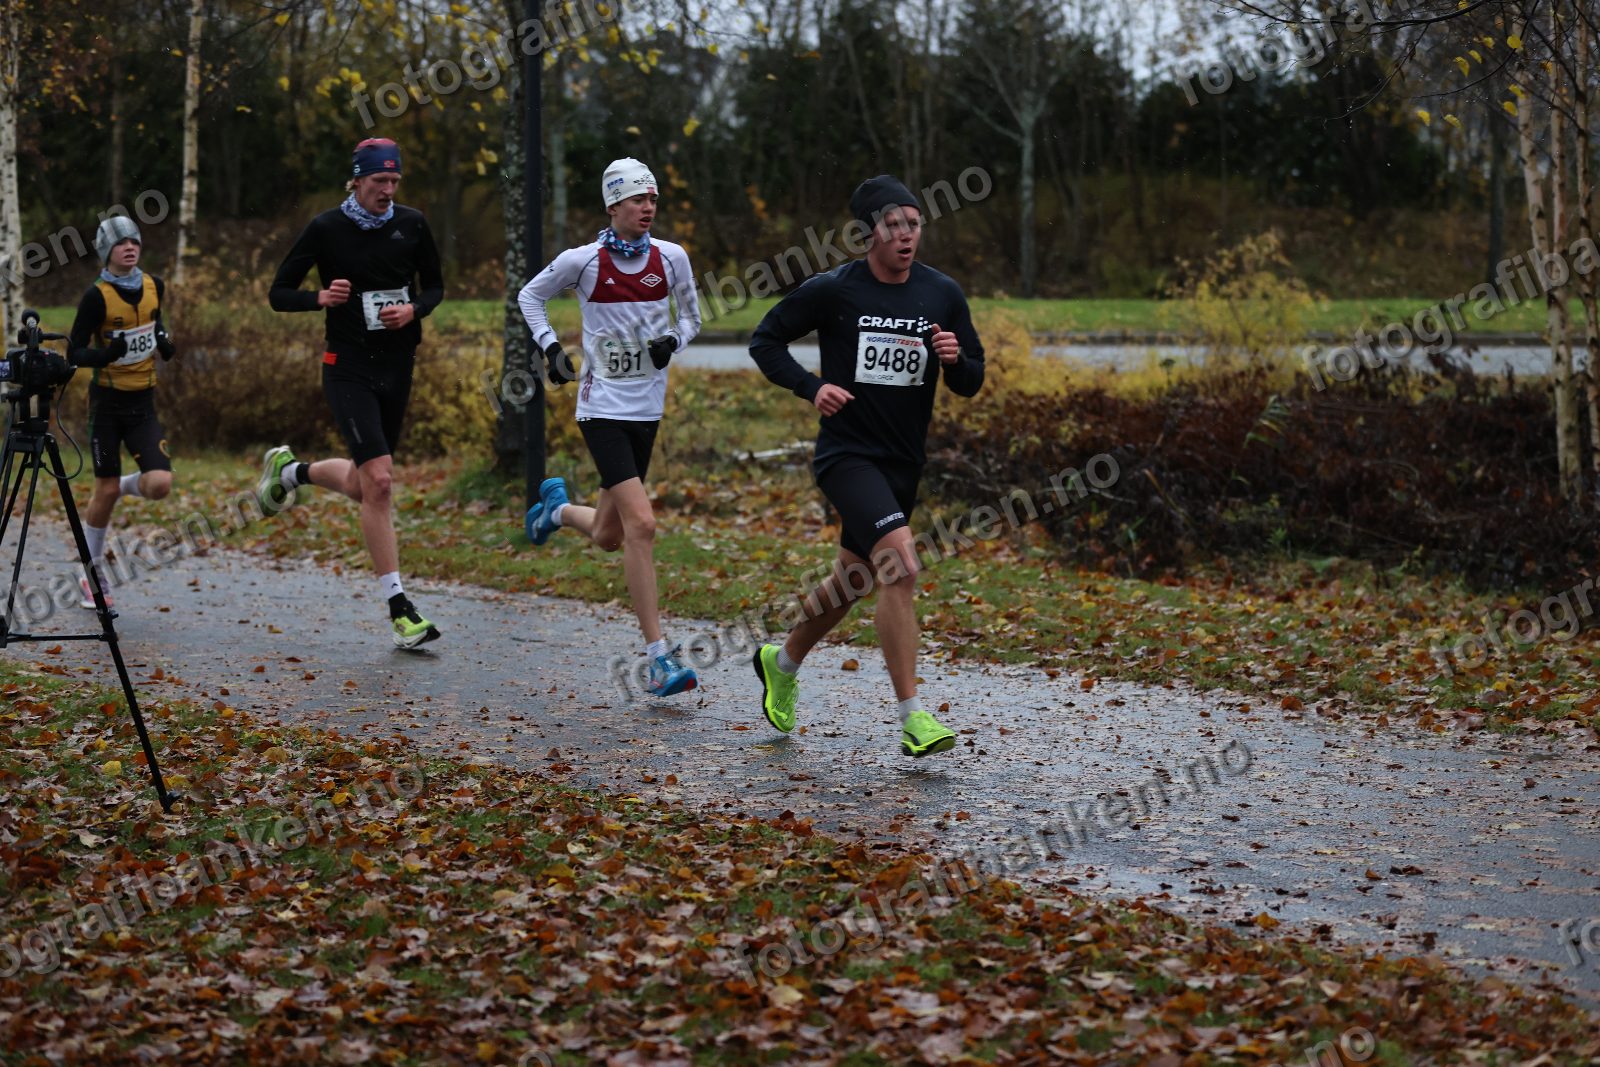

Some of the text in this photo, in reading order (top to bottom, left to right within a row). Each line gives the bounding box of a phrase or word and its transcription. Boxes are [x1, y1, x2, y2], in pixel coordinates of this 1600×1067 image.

[858, 315, 916, 330] CRAFT
[608, 351, 642, 373] 561
[864, 345, 921, 375] 9488
